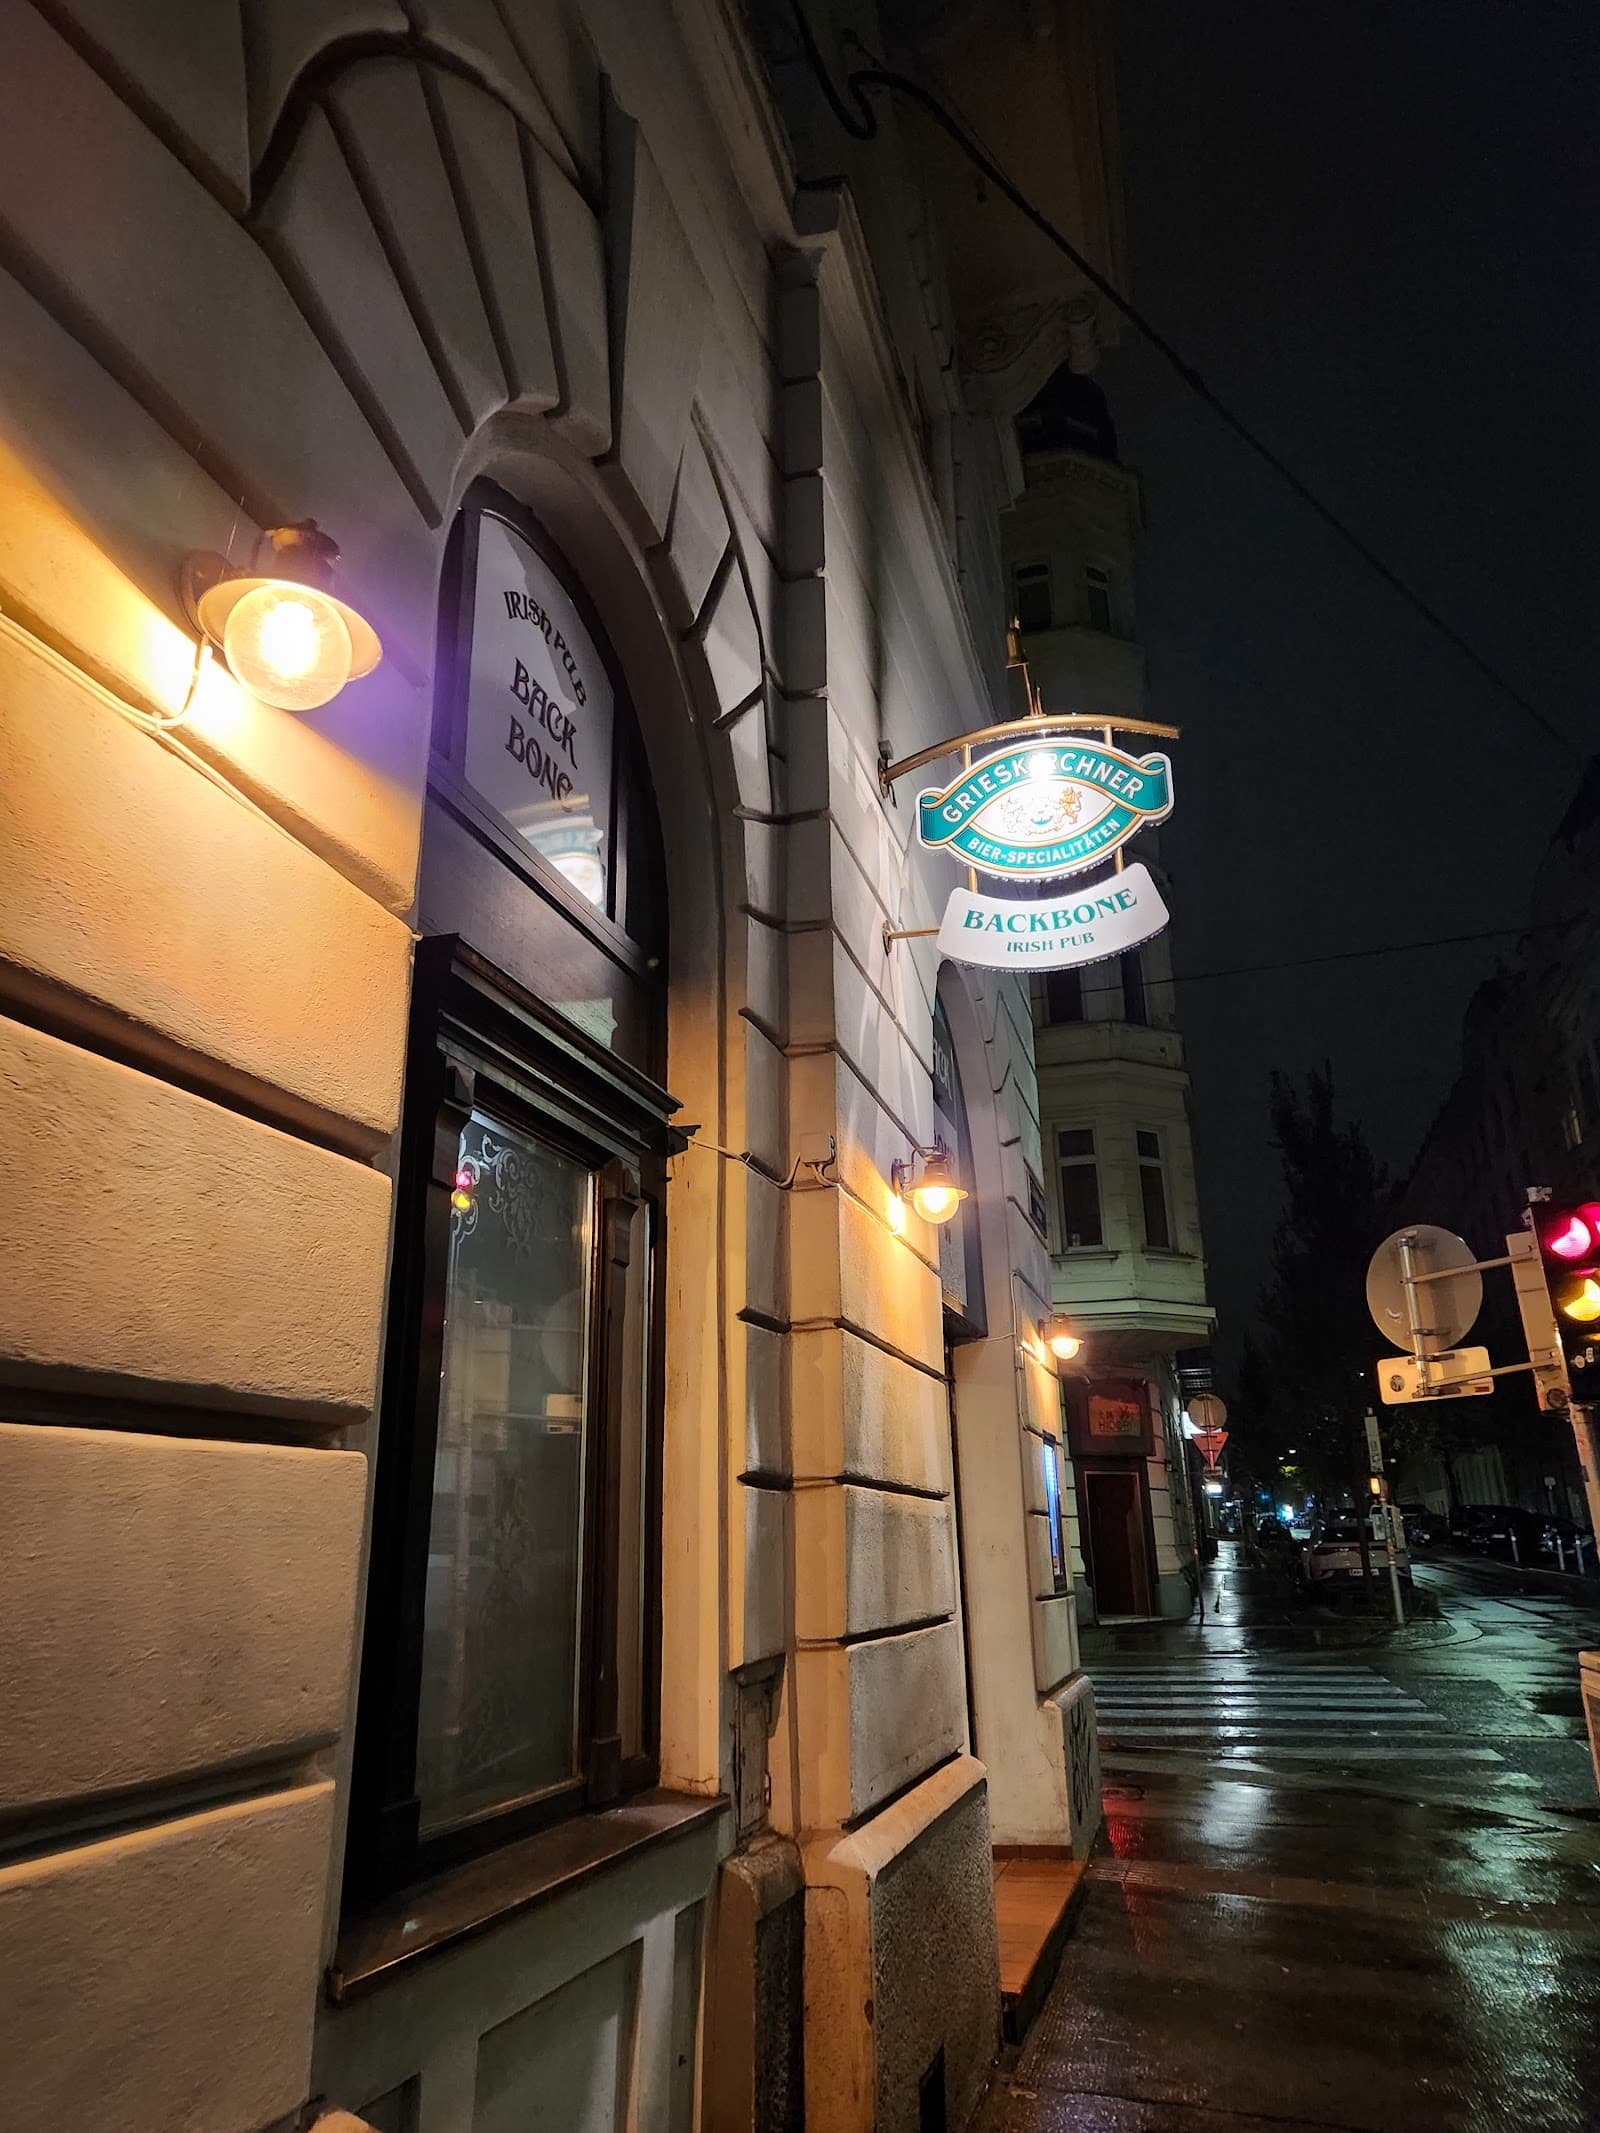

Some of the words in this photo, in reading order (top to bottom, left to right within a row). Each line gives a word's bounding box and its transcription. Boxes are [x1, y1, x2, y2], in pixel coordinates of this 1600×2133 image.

[510, 657, 578, 770] BACK
[967, 817, 1121, 865] BIER-SPECIALITÄTEN
[963, 888, 1138, 934] BACKBONE
[1007, 940, 1054, 953] IRISH
[1060, 932, 1095, 949] PUB
